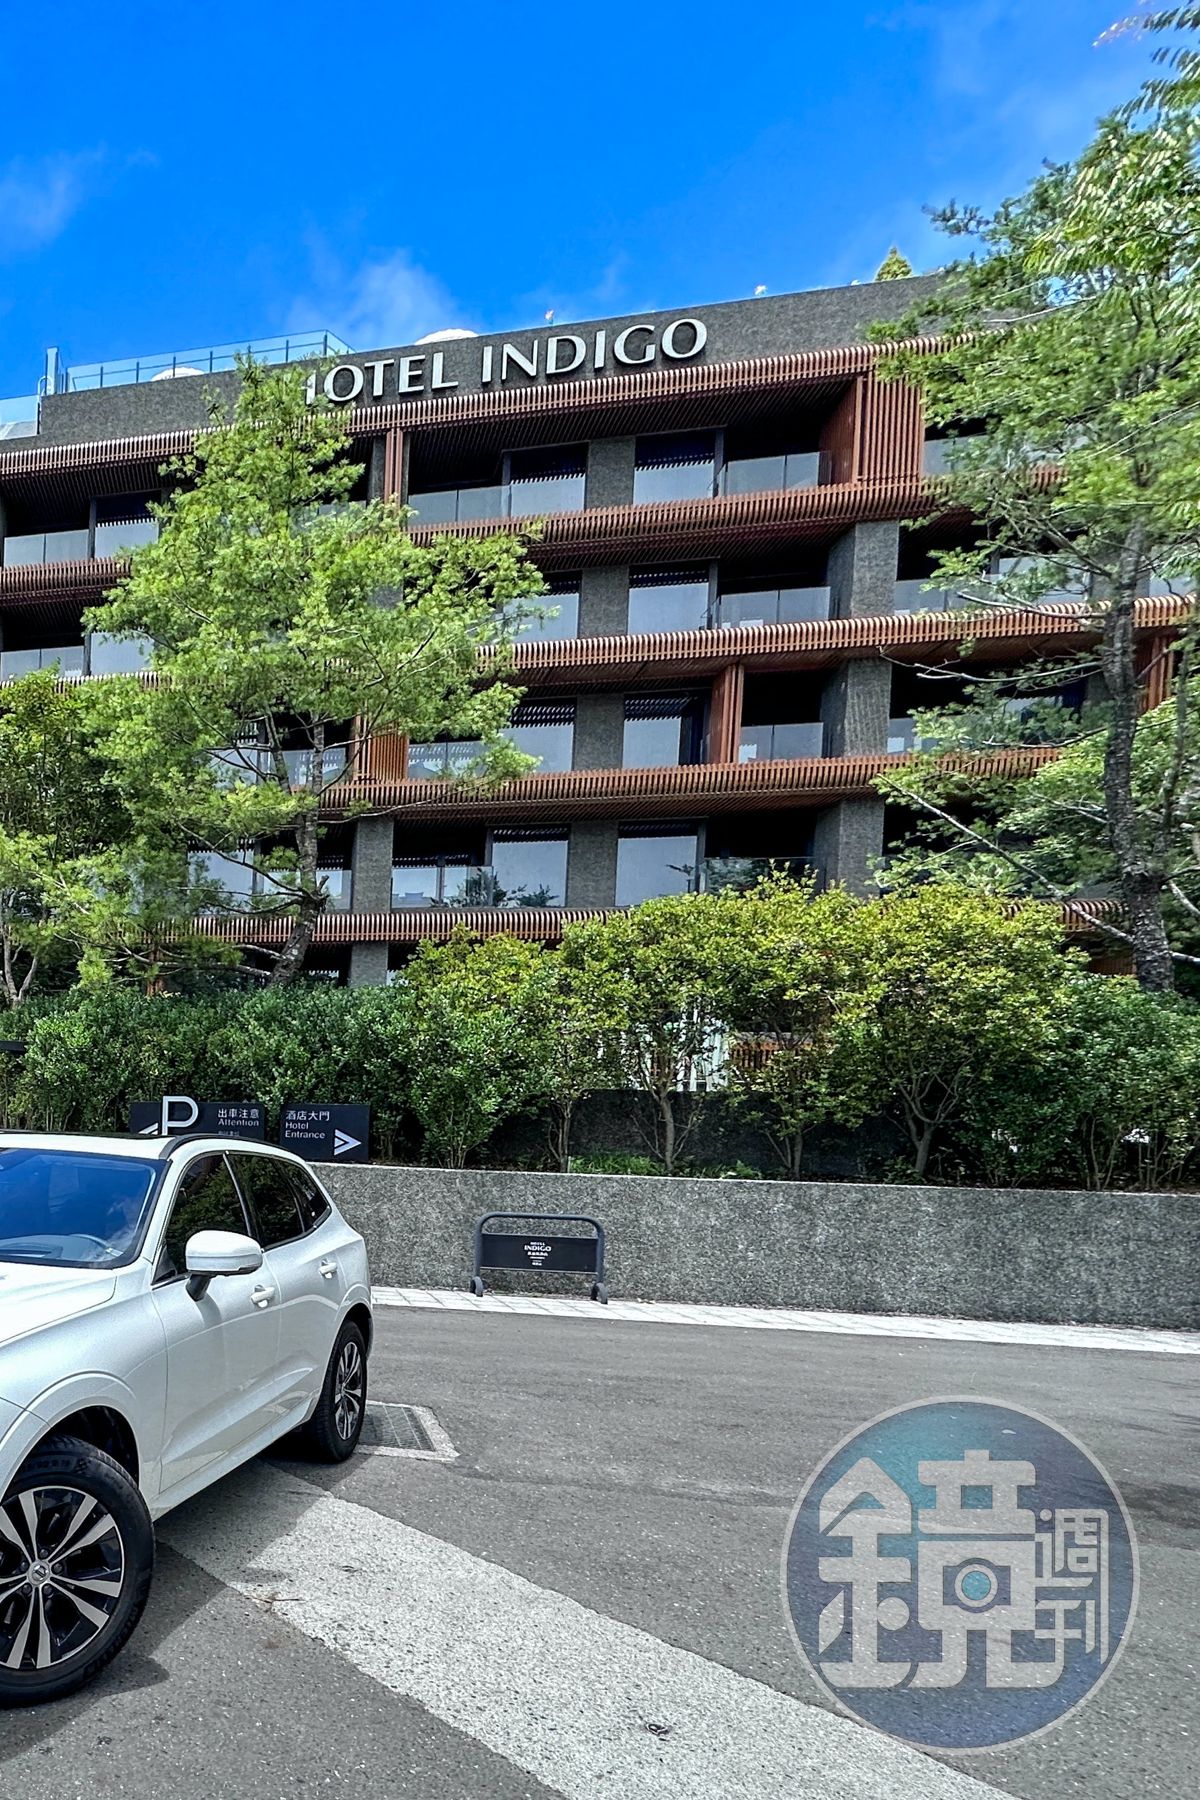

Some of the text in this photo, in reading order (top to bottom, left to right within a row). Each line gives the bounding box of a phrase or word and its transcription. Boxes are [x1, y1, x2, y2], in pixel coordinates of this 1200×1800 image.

[482, 318, 708, 384] INDIGO
[161, 1095, 199, 1136] P
[285, 1110, 330, 1121] 酒店大門
[218, 1118, 260, 1127] Attention
[285, 1121, 309, 1130] Hotel
[285, 1130, 326, 1139] Entrance
